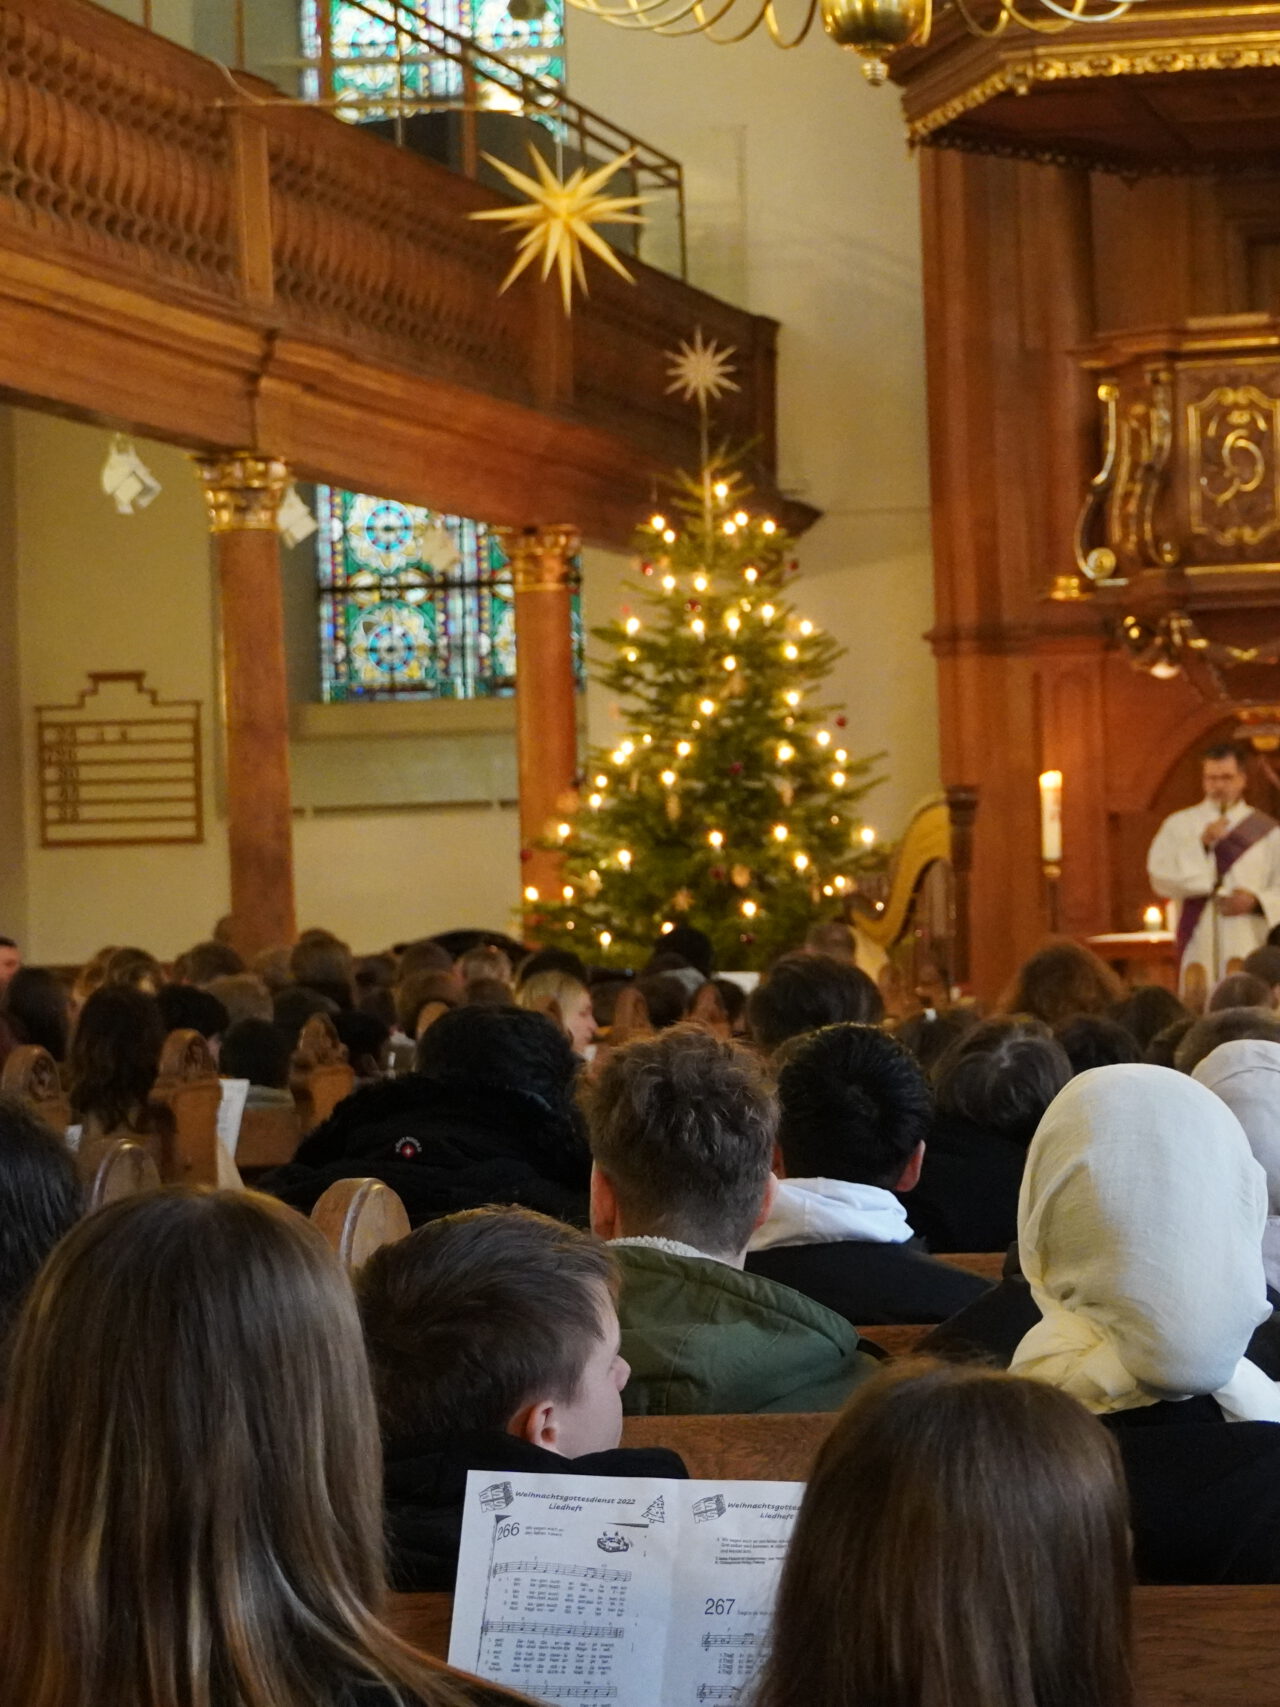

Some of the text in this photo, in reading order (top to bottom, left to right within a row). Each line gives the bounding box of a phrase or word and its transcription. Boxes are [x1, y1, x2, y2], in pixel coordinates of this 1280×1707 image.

[515, 1490, 636, 1505] Weihnachtsgottesdienst 2022
[548, 1503, 583, 1512] Liedheft
[497, 1522, 520, 1541] 266
[704, 1598, 736, 1615] 267
